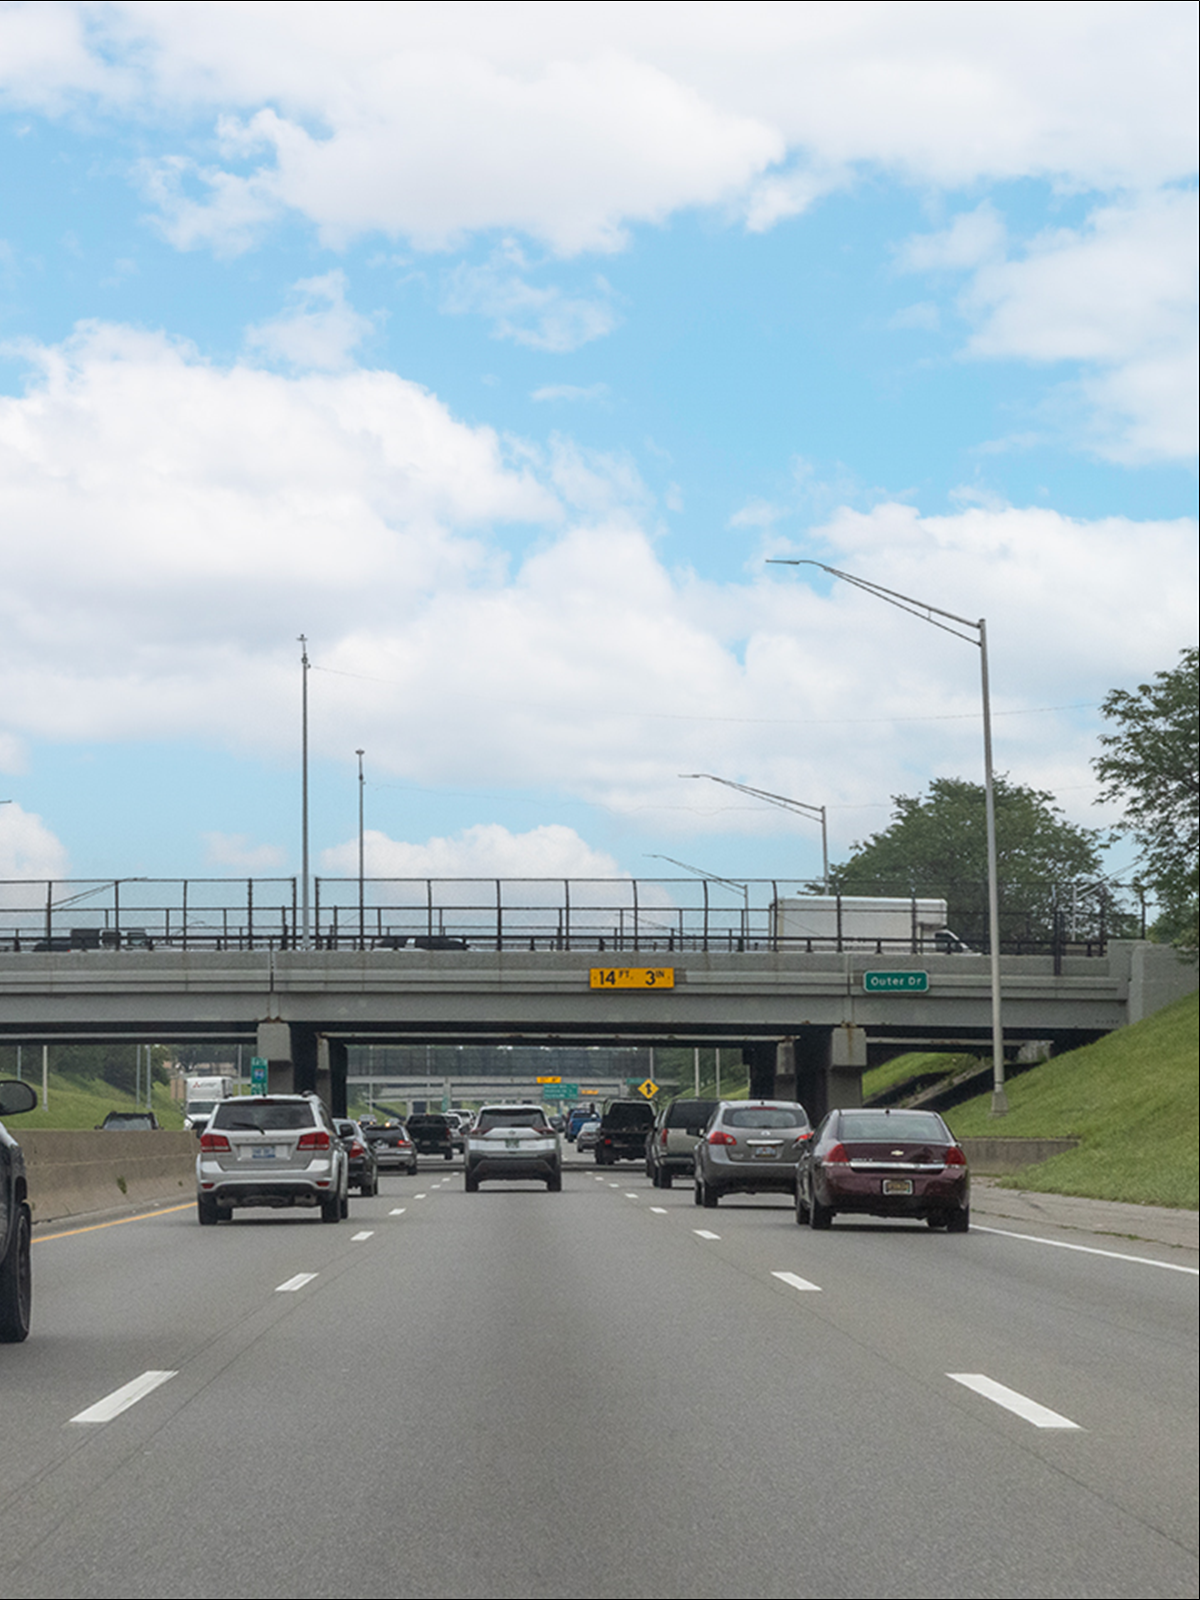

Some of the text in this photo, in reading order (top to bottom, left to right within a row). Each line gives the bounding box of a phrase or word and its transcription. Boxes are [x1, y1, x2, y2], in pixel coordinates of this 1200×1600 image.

[600, 970, 616, 985] 14
[645, 970, 656, 985] 3
[871, 976, 922, 986] Outer Dr
